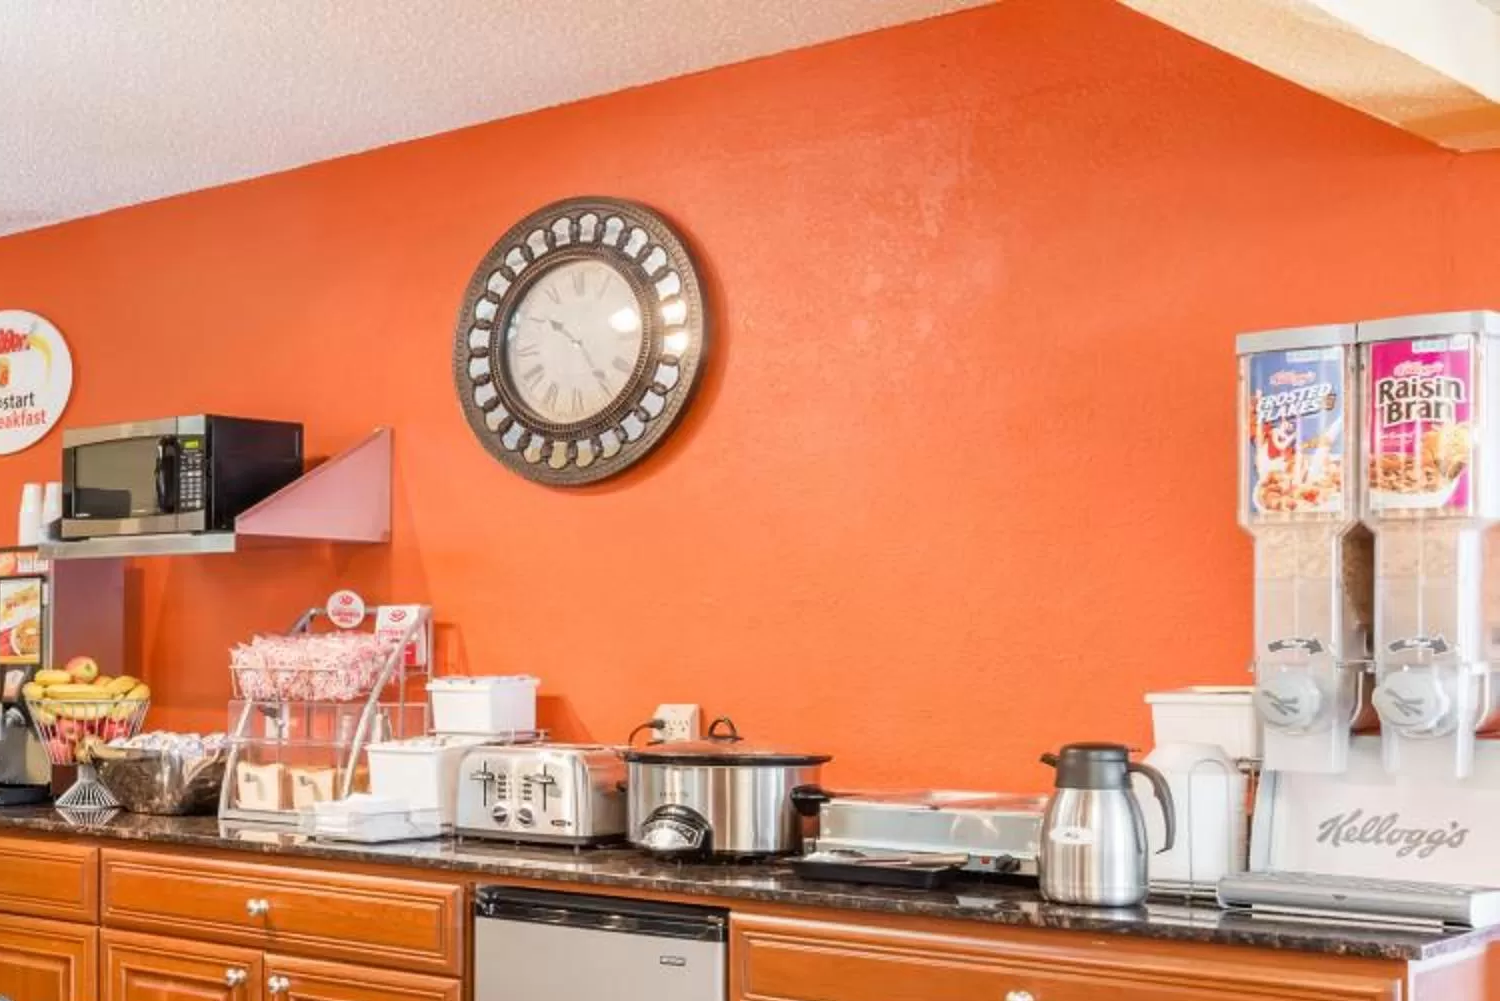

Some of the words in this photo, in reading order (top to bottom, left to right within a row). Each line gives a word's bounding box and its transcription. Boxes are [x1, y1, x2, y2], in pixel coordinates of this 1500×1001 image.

[1378, 377, 1461, 405] Raisin
[1386, 399, 1452, 424] Bran
[1316, 808, 1470, 859] Kellogg's
